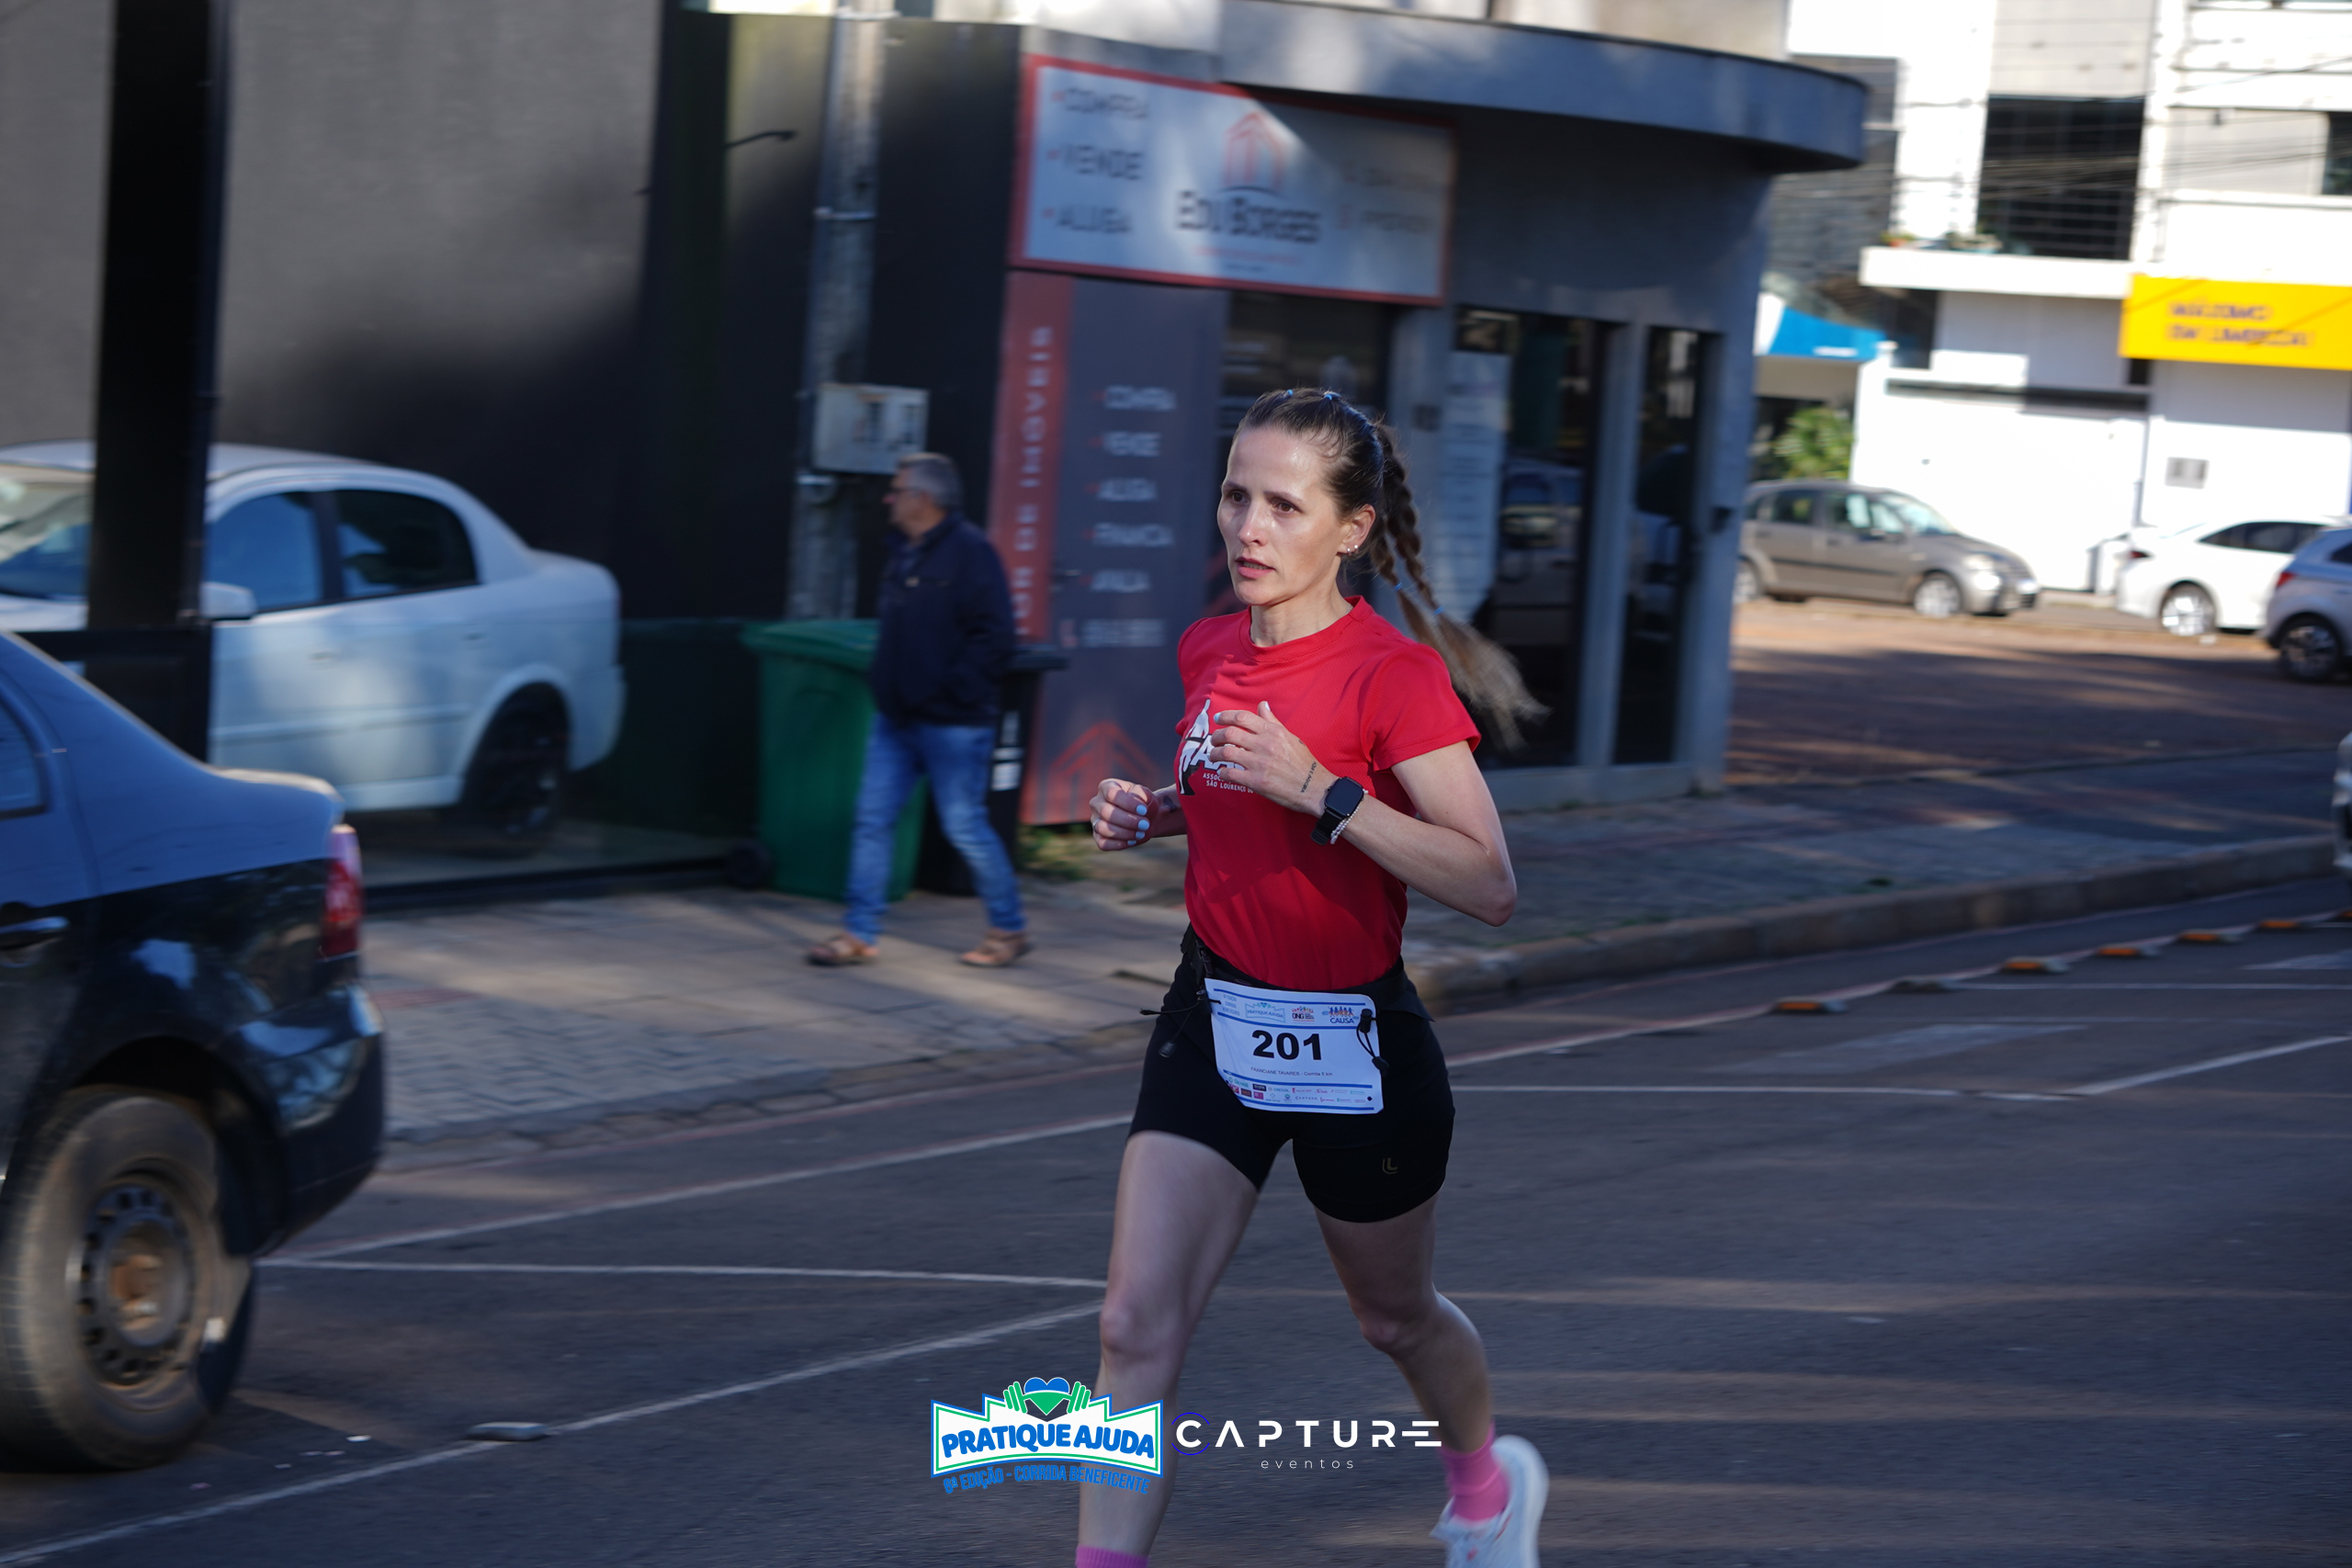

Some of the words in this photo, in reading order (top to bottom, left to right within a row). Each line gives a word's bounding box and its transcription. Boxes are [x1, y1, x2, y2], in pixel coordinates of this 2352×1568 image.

[1202, 773, 1225, 782] ASSOC
[1205, 780, 1218, 788] SÃO
[1219, 782, 1247, 793] LOURENÇO
[1251, 1030, 1322, 1061] 201
[1250, 1066, 1277, 1076] FRANCIANE
